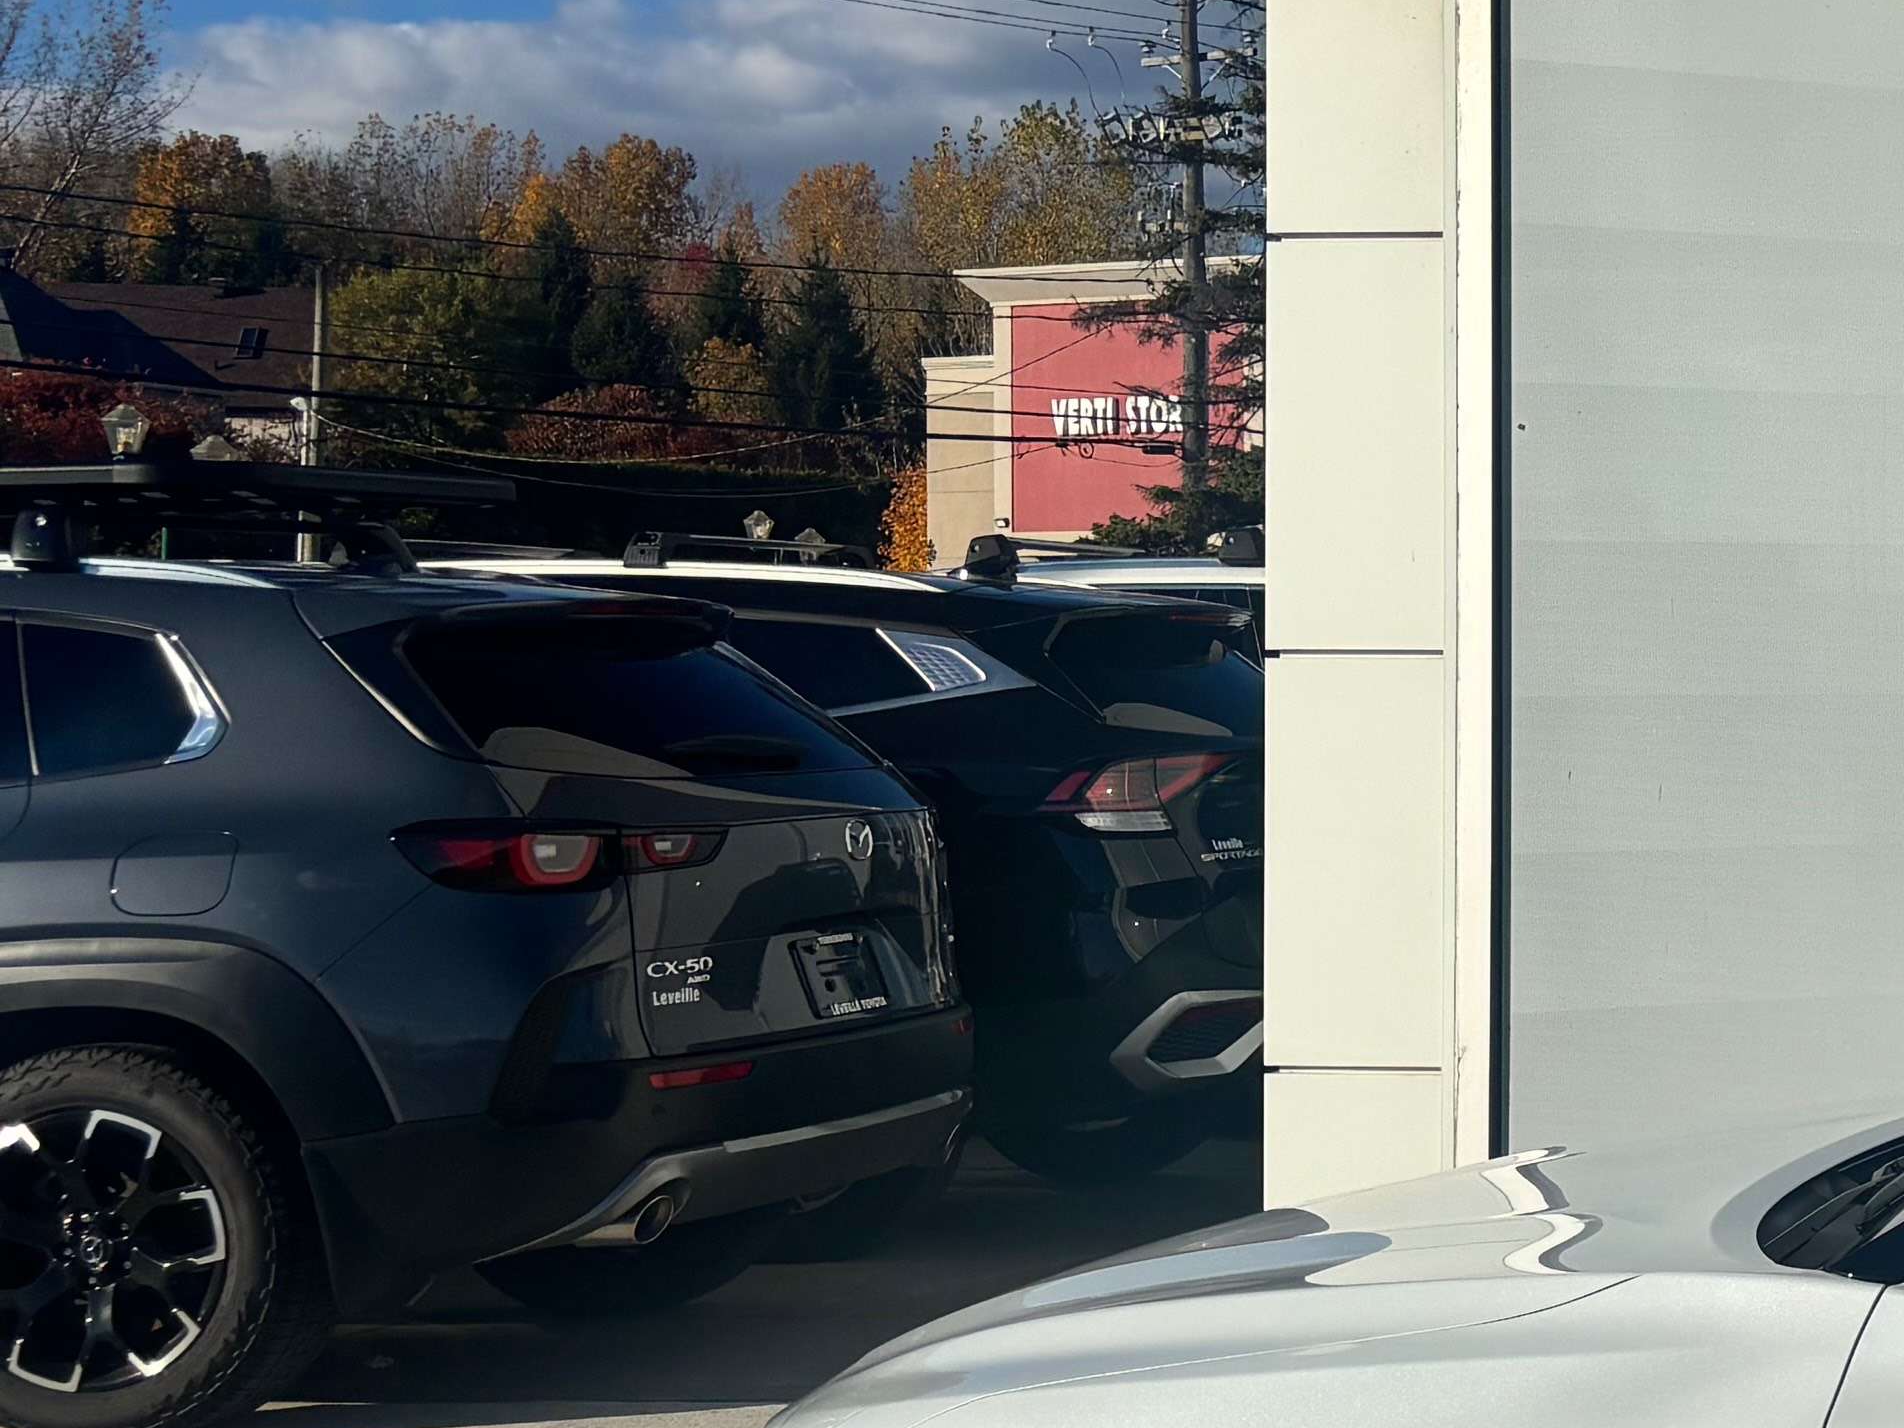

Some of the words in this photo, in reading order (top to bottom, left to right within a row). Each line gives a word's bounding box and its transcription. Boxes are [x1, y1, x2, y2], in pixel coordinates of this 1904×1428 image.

[1051, 396, 1116, 436] VERTI
[1125, 394, 1185, 436] STOR
[646, 956, 713, 978] CX-50
